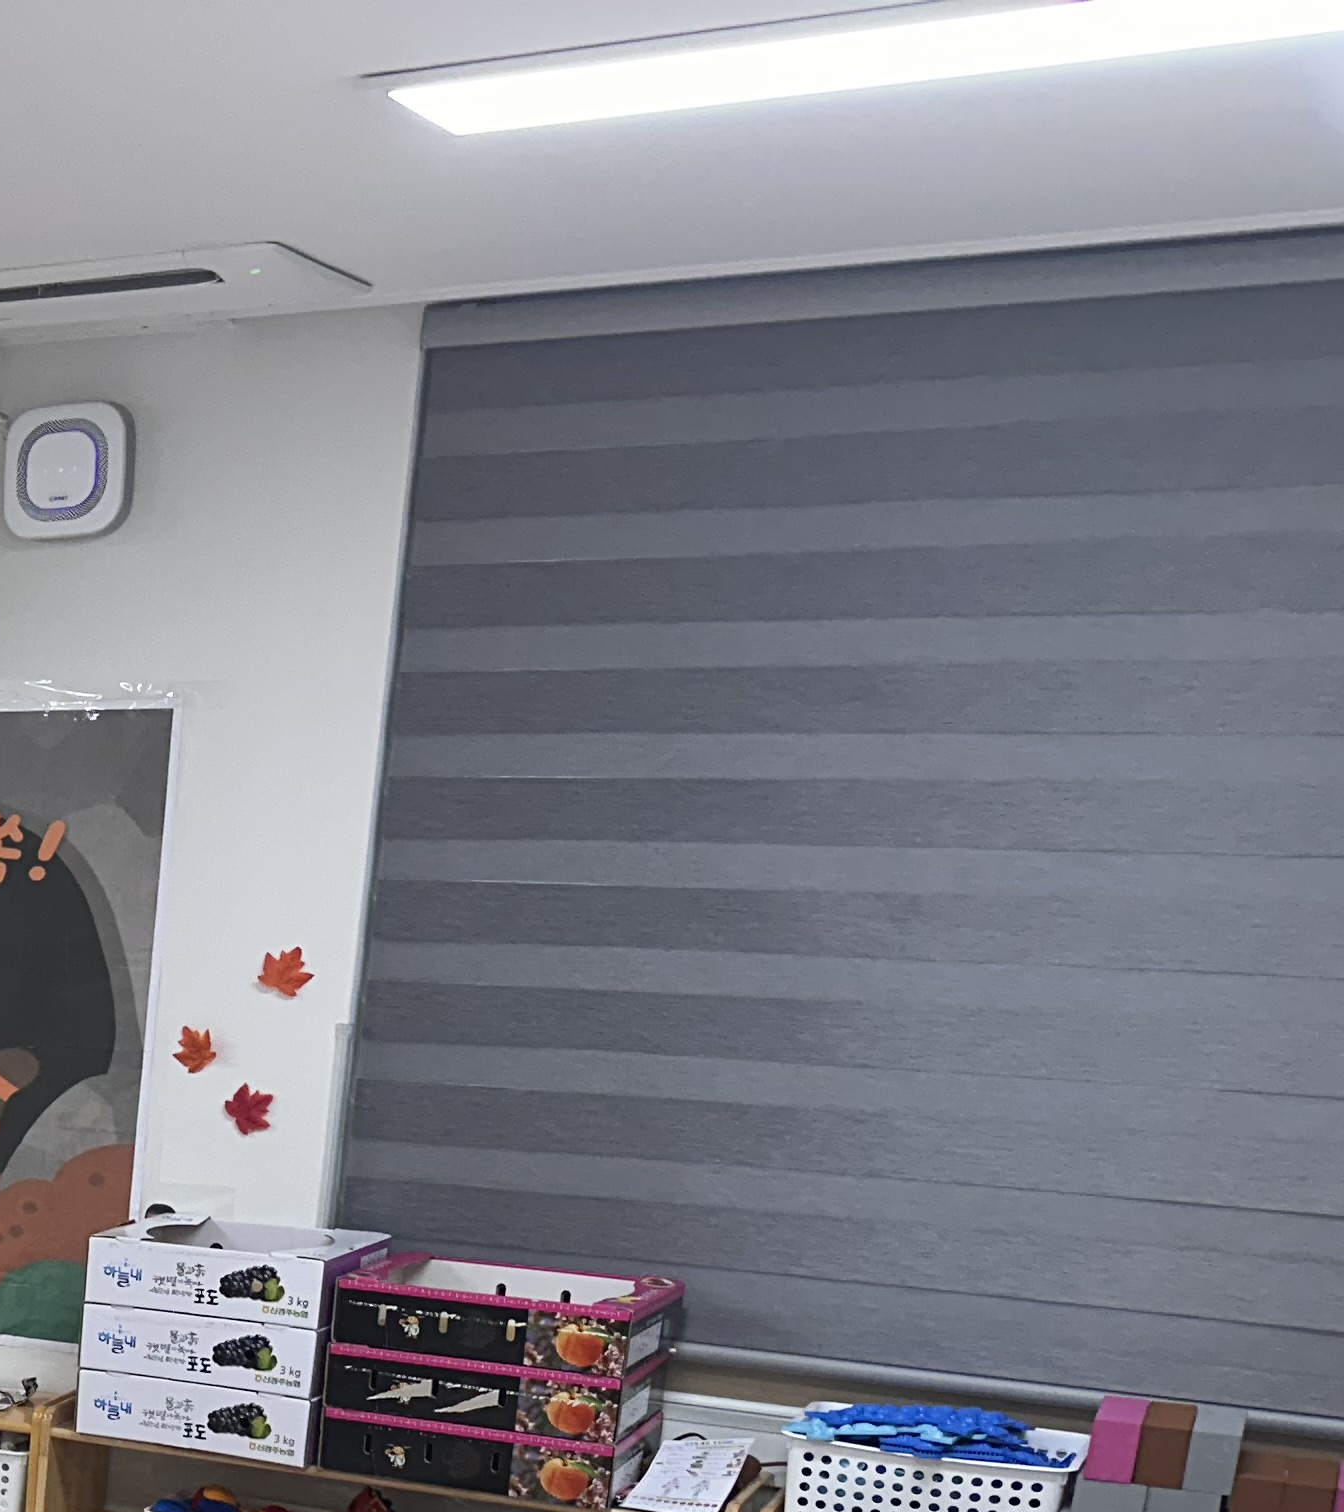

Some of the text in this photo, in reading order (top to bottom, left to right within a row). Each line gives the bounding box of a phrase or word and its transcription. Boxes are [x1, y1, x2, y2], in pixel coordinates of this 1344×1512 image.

[194, 1288, 219, 1305] 포도
[287, 1296, 309, 1309] 3 kg
[187, 1356, 212, 1374] 포도
[279, 1365, 301, 1378] 3 kg
[183, 1423, 207, 1440] 포도
[273, 1434, 295, 1448] 3 kg
